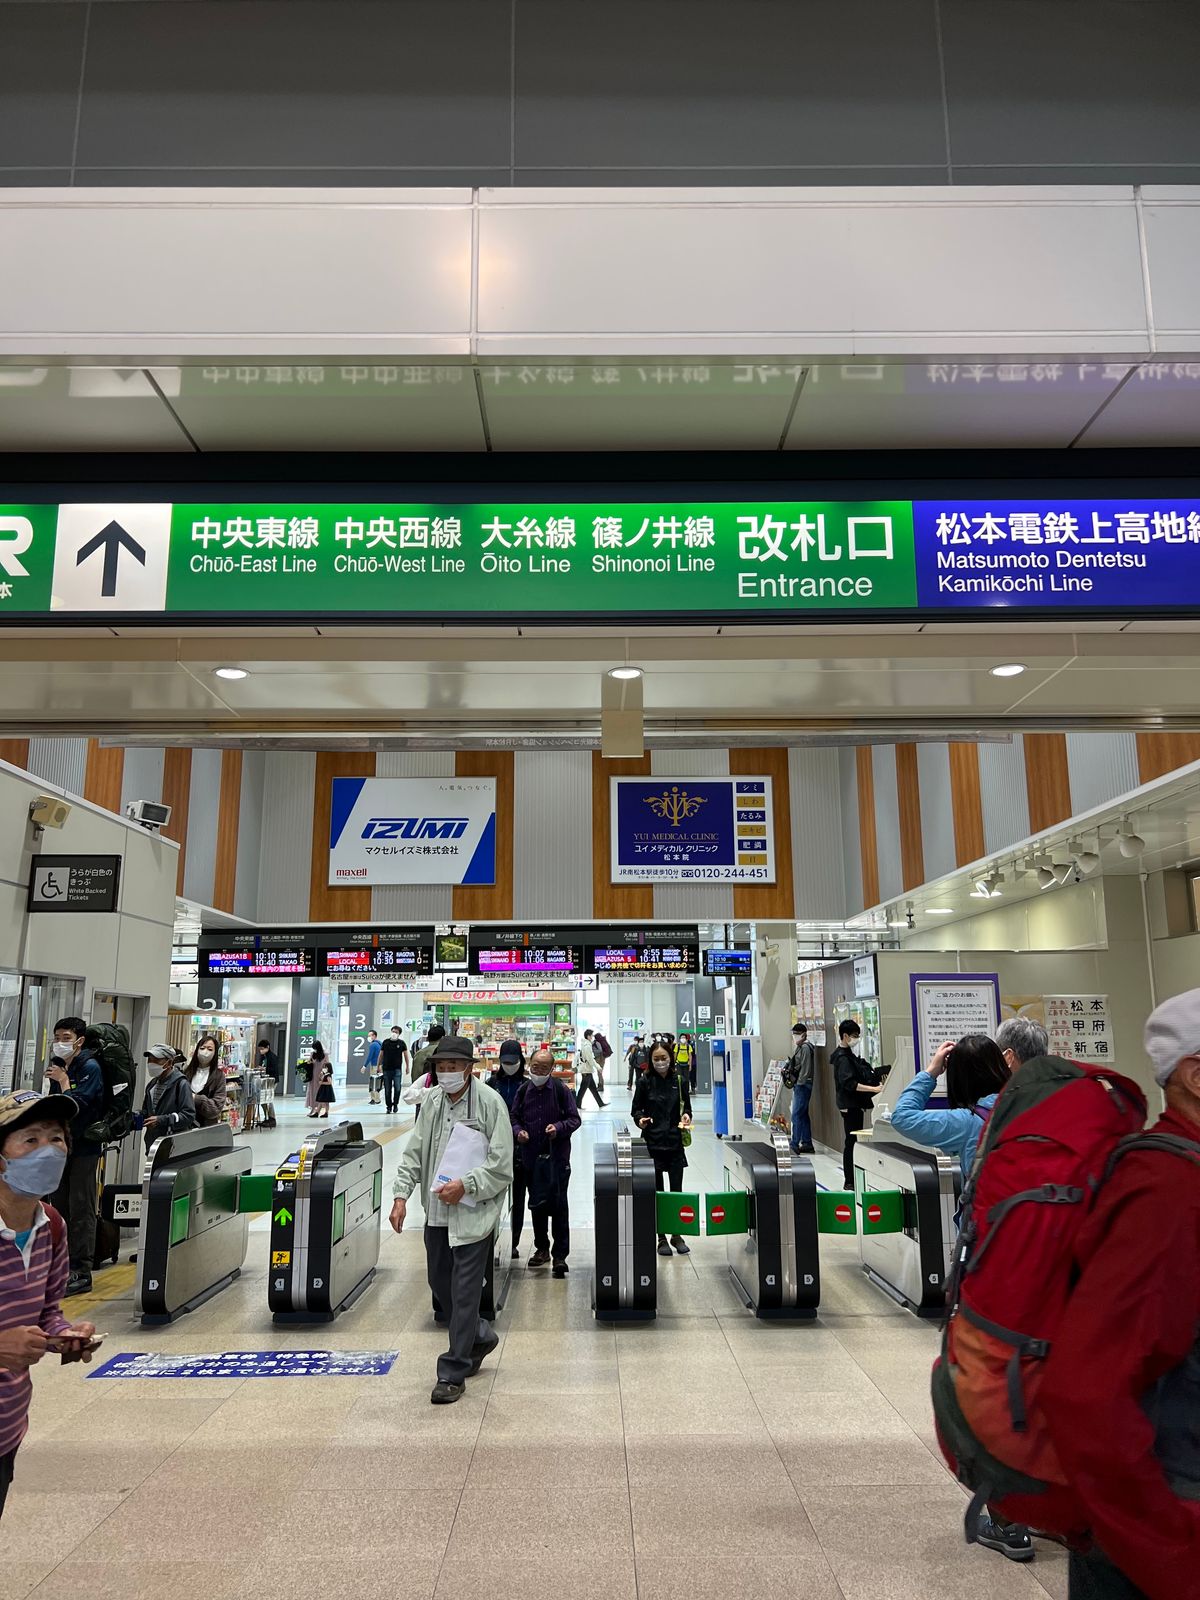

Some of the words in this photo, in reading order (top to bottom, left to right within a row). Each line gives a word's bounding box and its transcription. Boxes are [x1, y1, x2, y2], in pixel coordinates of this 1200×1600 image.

[191, 516, 320, 549] 中央東線
[334, 516, 462, 549] 中央西線
[480, 515, 577, 549] 大糸線
[591, 516, 716, 549] 篠ノ井線
[736, 513, 894, 562] 改札口
[190, 554, 278, 573] Chūō-East
[283, 554, 317, 573] Line
[333, 554, 426, 573] Chūō-West
[431, 555, 466, 573] Line
[480, 552, 522, 573] Ōito
[529, 554, 571, 573] Line
[591, 554, 671, 573] Shinonoi
[677, 554, 716, 572] Line
[937, 551, 1050, 569] Matsumoto
[1056, 550, 1147, 568] Dentetsu
[738, 572, 873, 598] Entrance
[938, 574, 1044, 593] Kamikōchi
[1050, 574, 1093, 592] Line
[743, 784, 758, 792] シミ
[360, 817, 470, 839] IZUMI
[365, 846, 459, 855] マクセルイズミ株式会社
[70, 868, 112, 877] うらが白色の
[336, 868, 367, 876] maxell
[694, 868, 768, 878] 0120-244-451
[70, 878, 92, 886] きっぷ
[340, 996, 346, 1005] 3
[1070, 1000, 1103, 1011] 松本
[355, 1014, 365, 1029] 3
[680, 1012, 691, 1026] 4
[1072, 1020, 1105, 1031] 甲府
[354, 1037, 365, 1052] 2
[1074, 1041, 1108, 1053] 新宿
